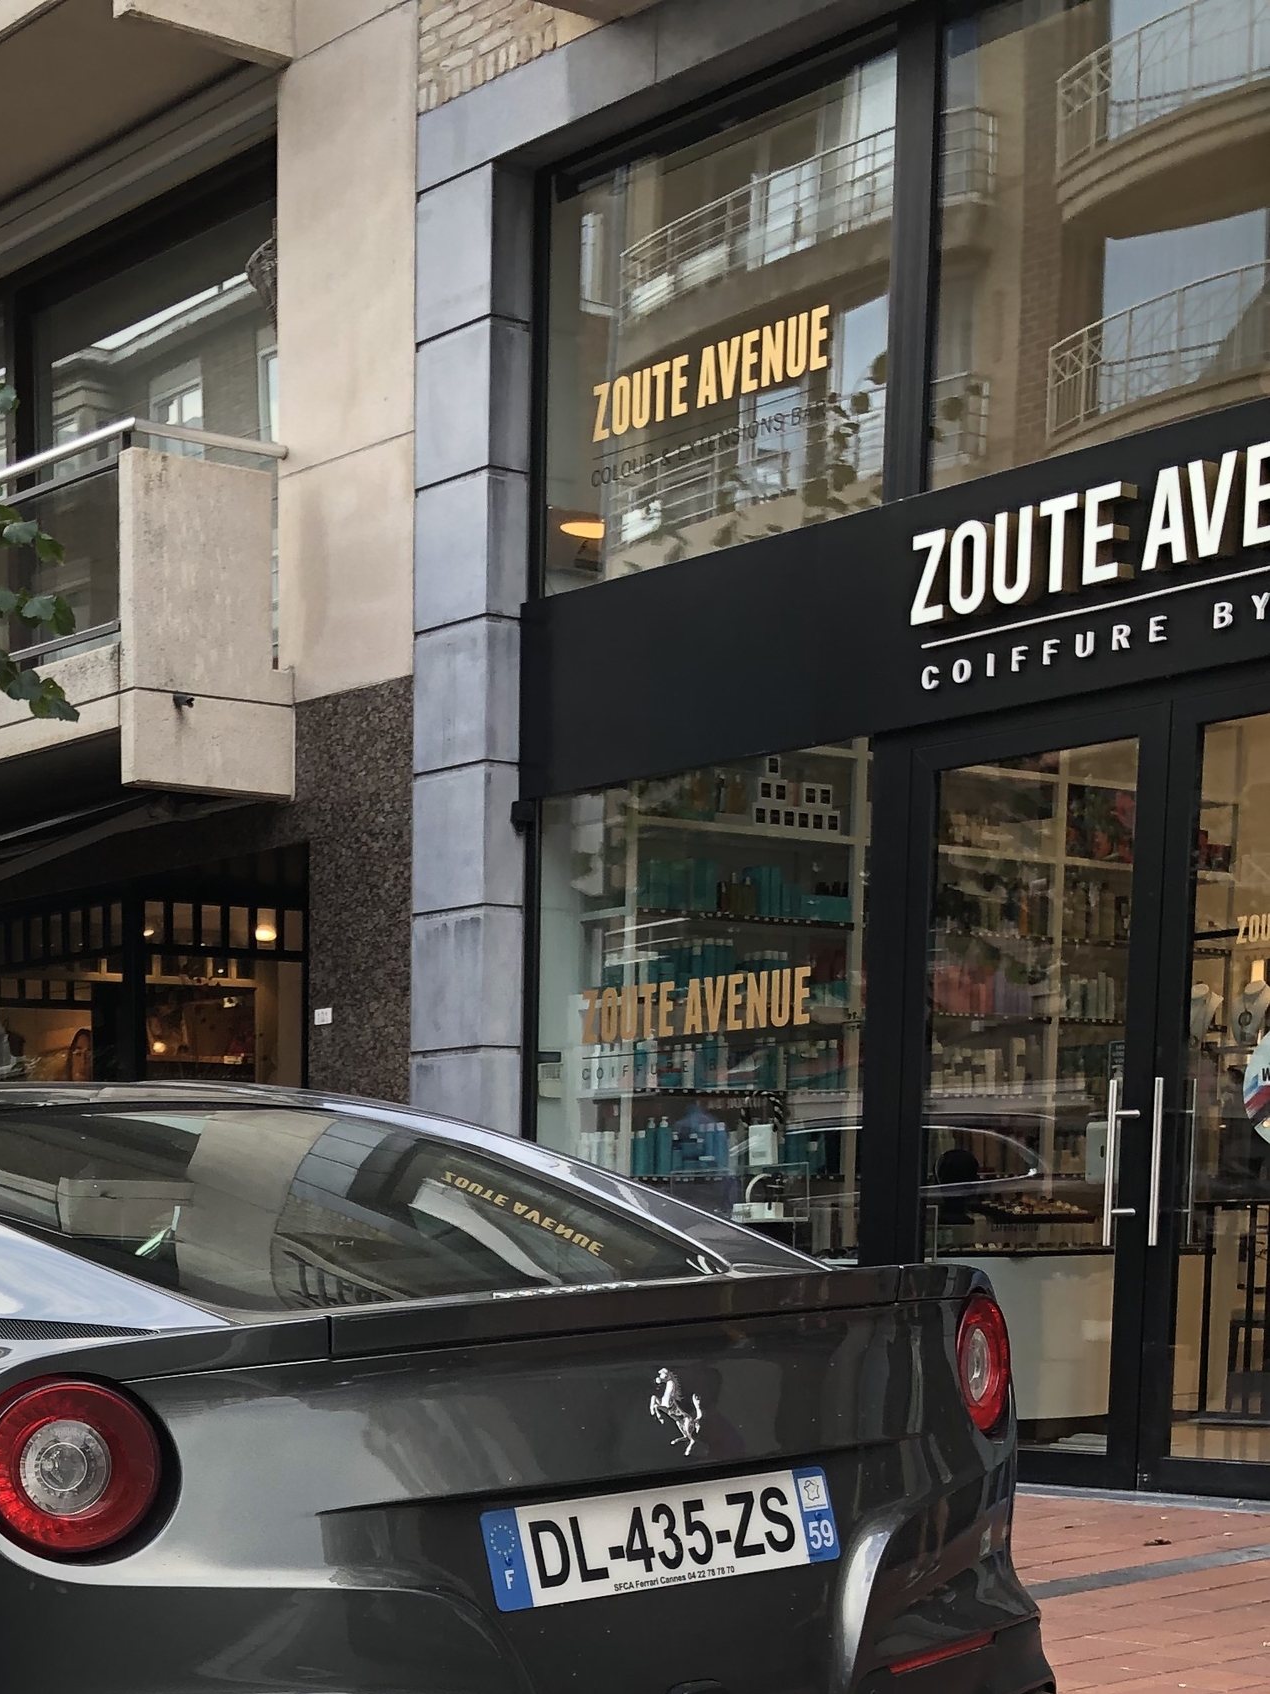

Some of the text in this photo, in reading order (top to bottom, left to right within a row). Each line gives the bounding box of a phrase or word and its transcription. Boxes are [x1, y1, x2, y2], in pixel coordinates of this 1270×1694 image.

[592, 304, 830, 443] ZOUTE AVENUE
[591, 453, 654, 488] COLOUR
[910, 480, 1130, 626] ZOUTE
[921, 591, 1270, 691] COIFFURE BY
[582, 966, 812, 1044] ZOUTE AVENUE
[528, 1486, 796, 1590] DL-435-ZS
[808, 1519, 835, 1550] 59
[505, 1569, 515, 1591] F
[613, 1581, 635, 1592] SFCA
[635, 1577, 659, 1589] Ferrari
[659, 1573, 687, 1585] Cannes
[697, 1570, 707, 1579] 22
[726, 1565, 736, 1574] 70
